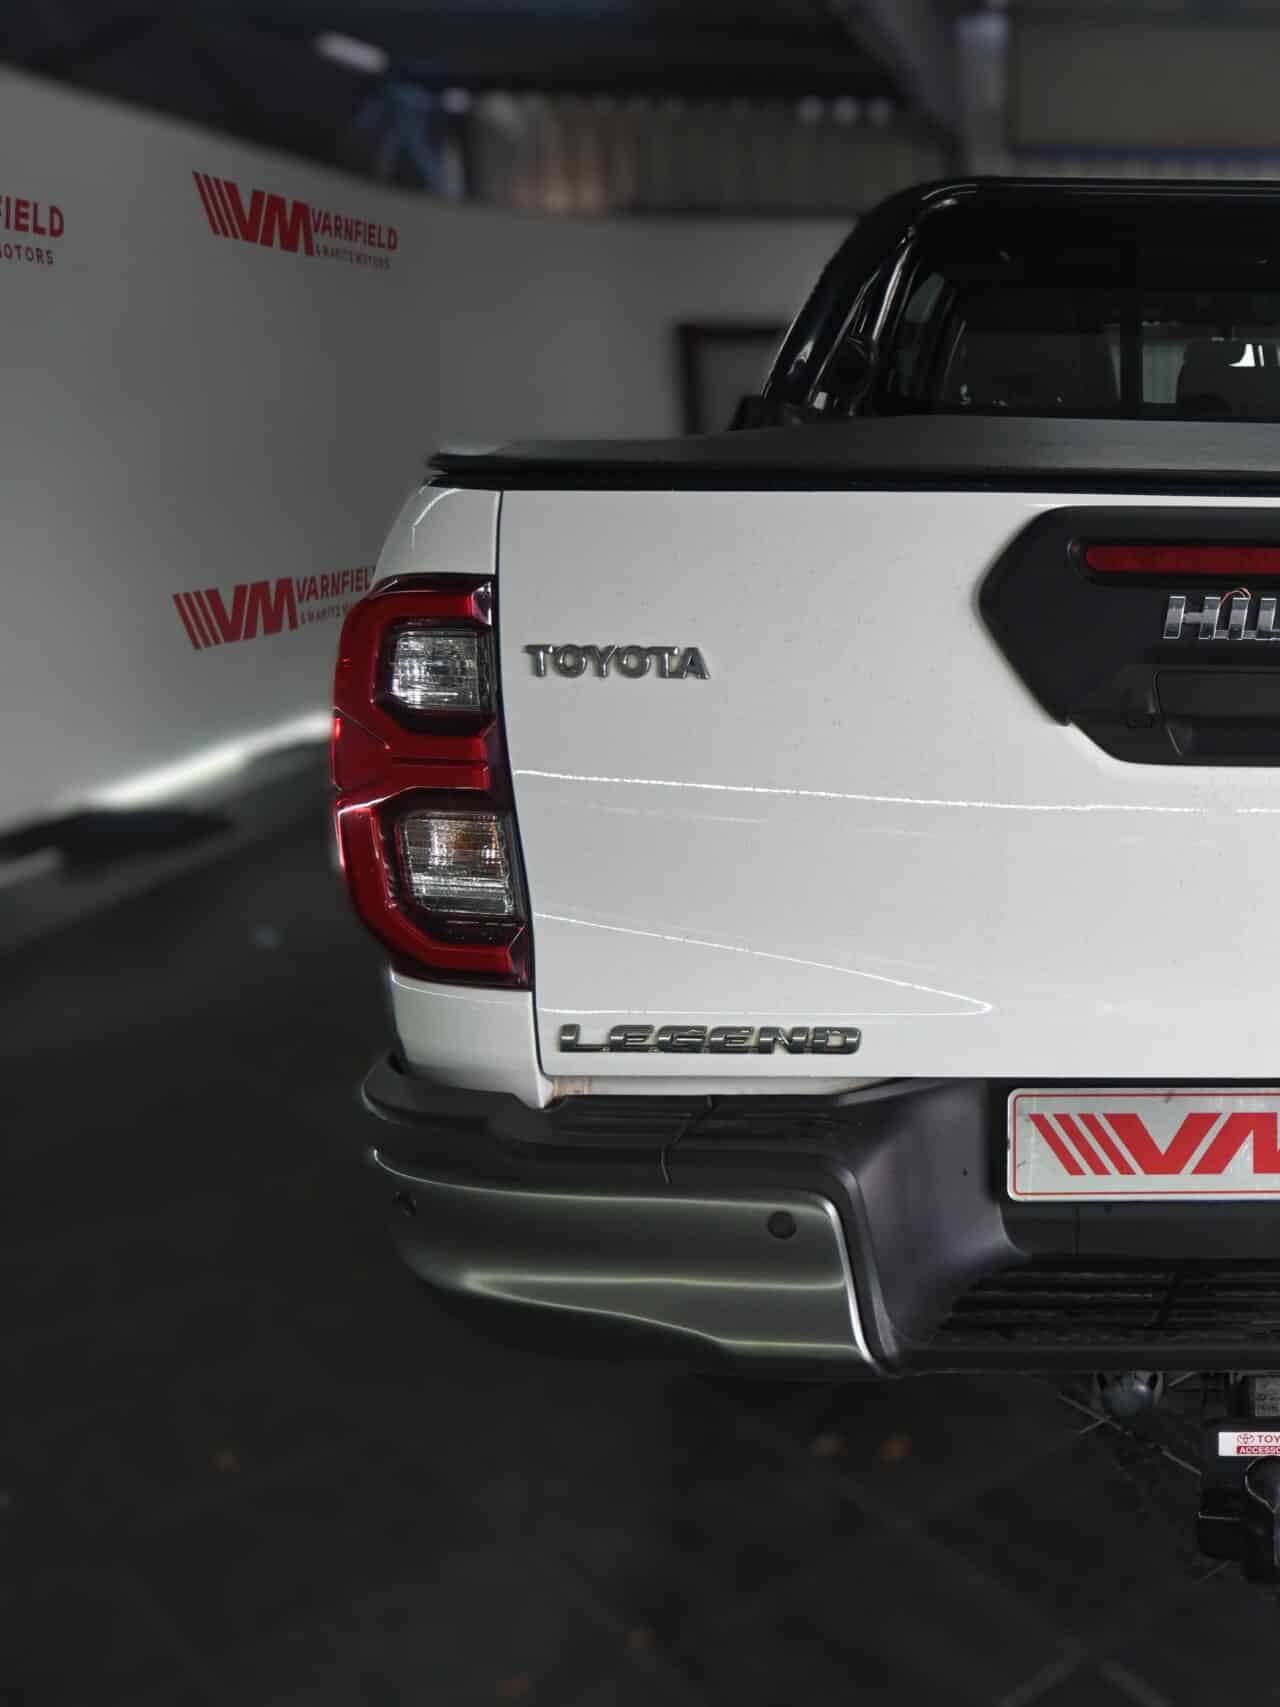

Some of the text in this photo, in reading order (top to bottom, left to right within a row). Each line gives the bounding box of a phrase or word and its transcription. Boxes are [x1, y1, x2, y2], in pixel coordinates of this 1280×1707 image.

[0, 194, 65, 238] IELD
[311, 208, 399, 251] VARNFIELD
[0, 243, 54, 265] OTORS
[296, 567, 376, 603] VARNFIEL
[523, 643, 711, 680] TOYOTA
[559, 1023, 862, 1055] LEGEND
